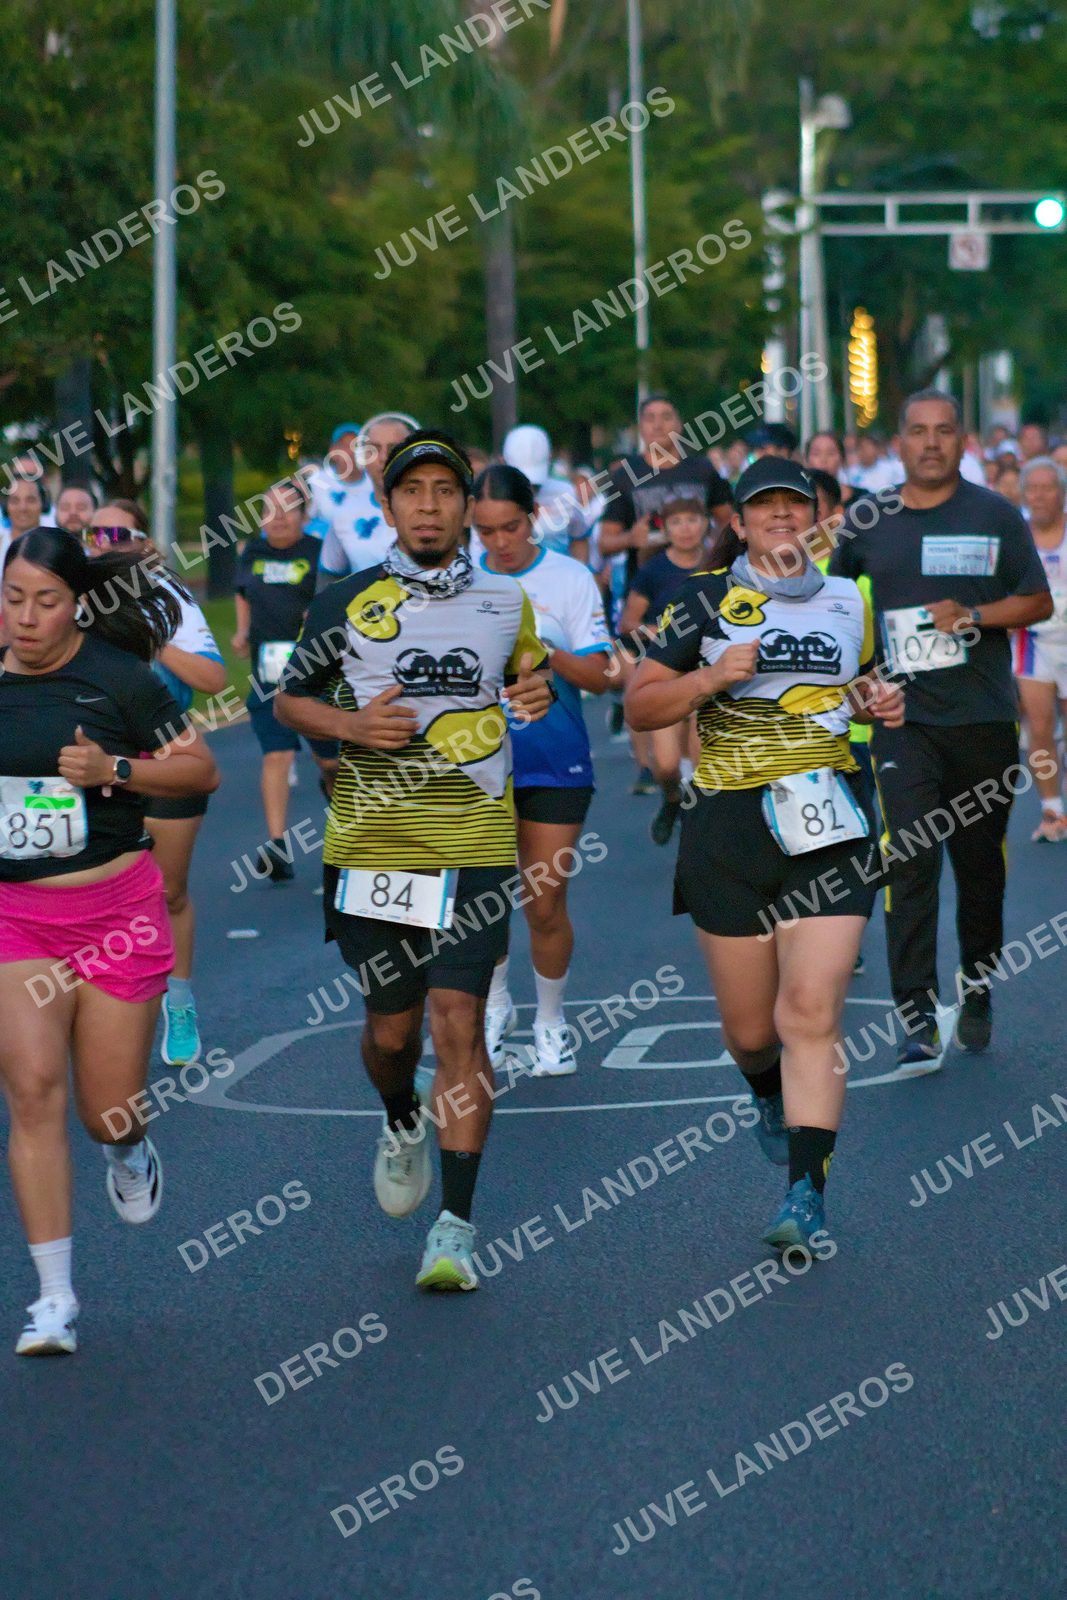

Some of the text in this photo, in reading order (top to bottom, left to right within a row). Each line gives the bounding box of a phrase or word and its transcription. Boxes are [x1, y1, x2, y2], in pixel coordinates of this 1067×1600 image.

[9, 812, 72, 849] 851
[801, 798, 845, 836] 82
[370, 872, 413, 912] 84
